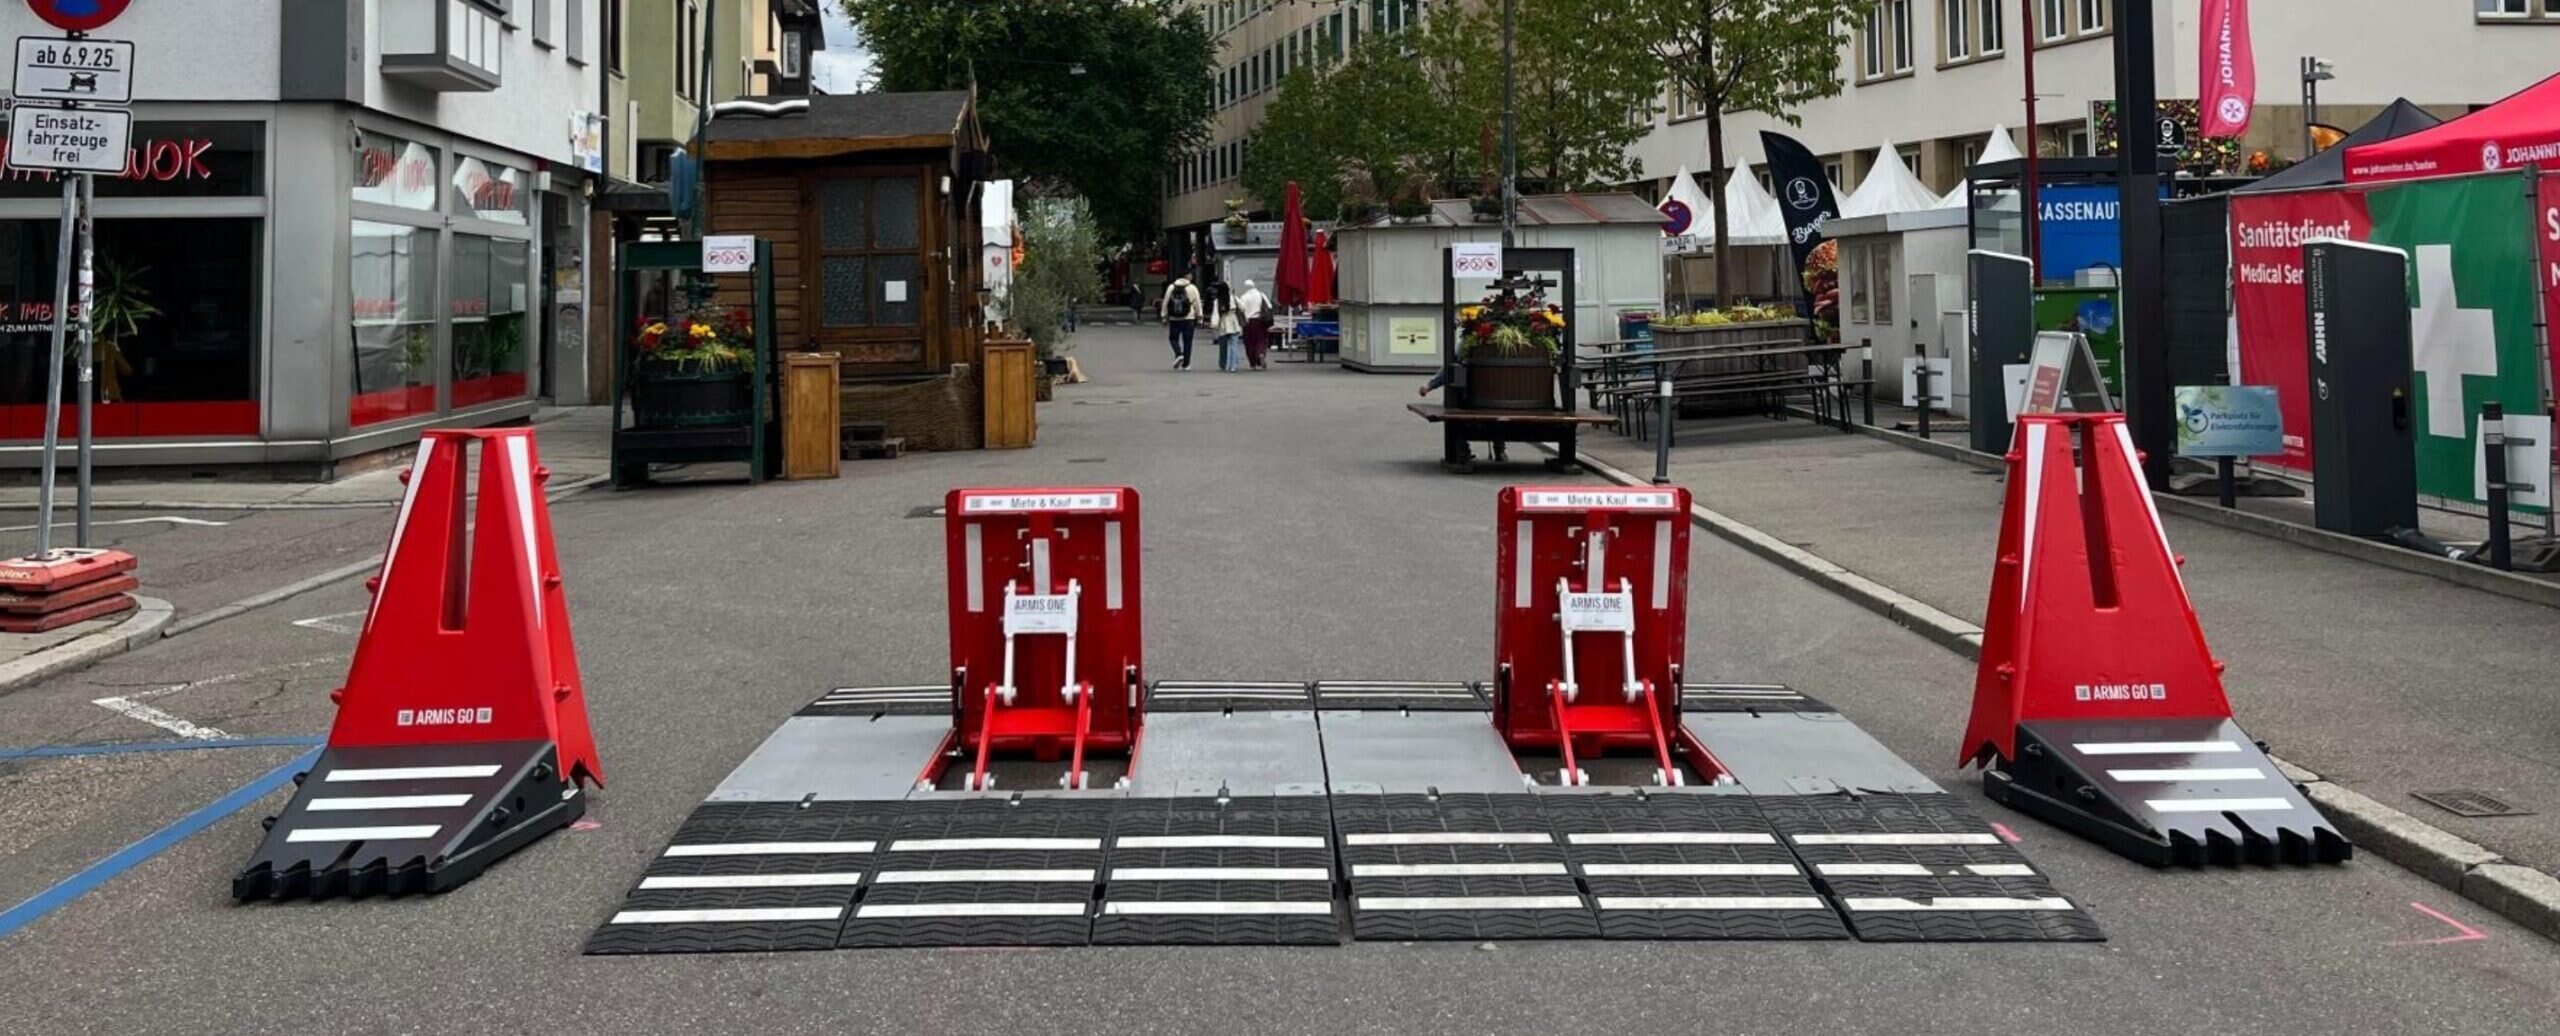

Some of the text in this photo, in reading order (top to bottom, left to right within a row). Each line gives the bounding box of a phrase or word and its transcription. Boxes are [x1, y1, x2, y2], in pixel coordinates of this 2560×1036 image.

[37, 46, 114, 67] ab 6.9.25
[35, 114, 101, 131] Einsatz-
[27, 130, 108, 150] fahrzeuge
[53, 148, 80, 163] frei
[1791, 212, 1831, 244] Burger
[2240, 263, 2304, 284] Medical Ser
[1011, 497, 1036, 509] Miete
[1039, 496, 1046, 508] &
[1049, 496, 1072, 508] Kauf
[1568, 494, 1593, 505] Miete
[1596, 495, 1603, 505] &
[1606, 494, 1628, 505] Kauf
[1014, 598, 1066, 611] ARMIS ONE
[1571, 597, 1622, 609] ARMIS ONE
[2093, 684, 2148, 700] ARMIS GO
[416, 707, 474, 725] ARMIS GO
